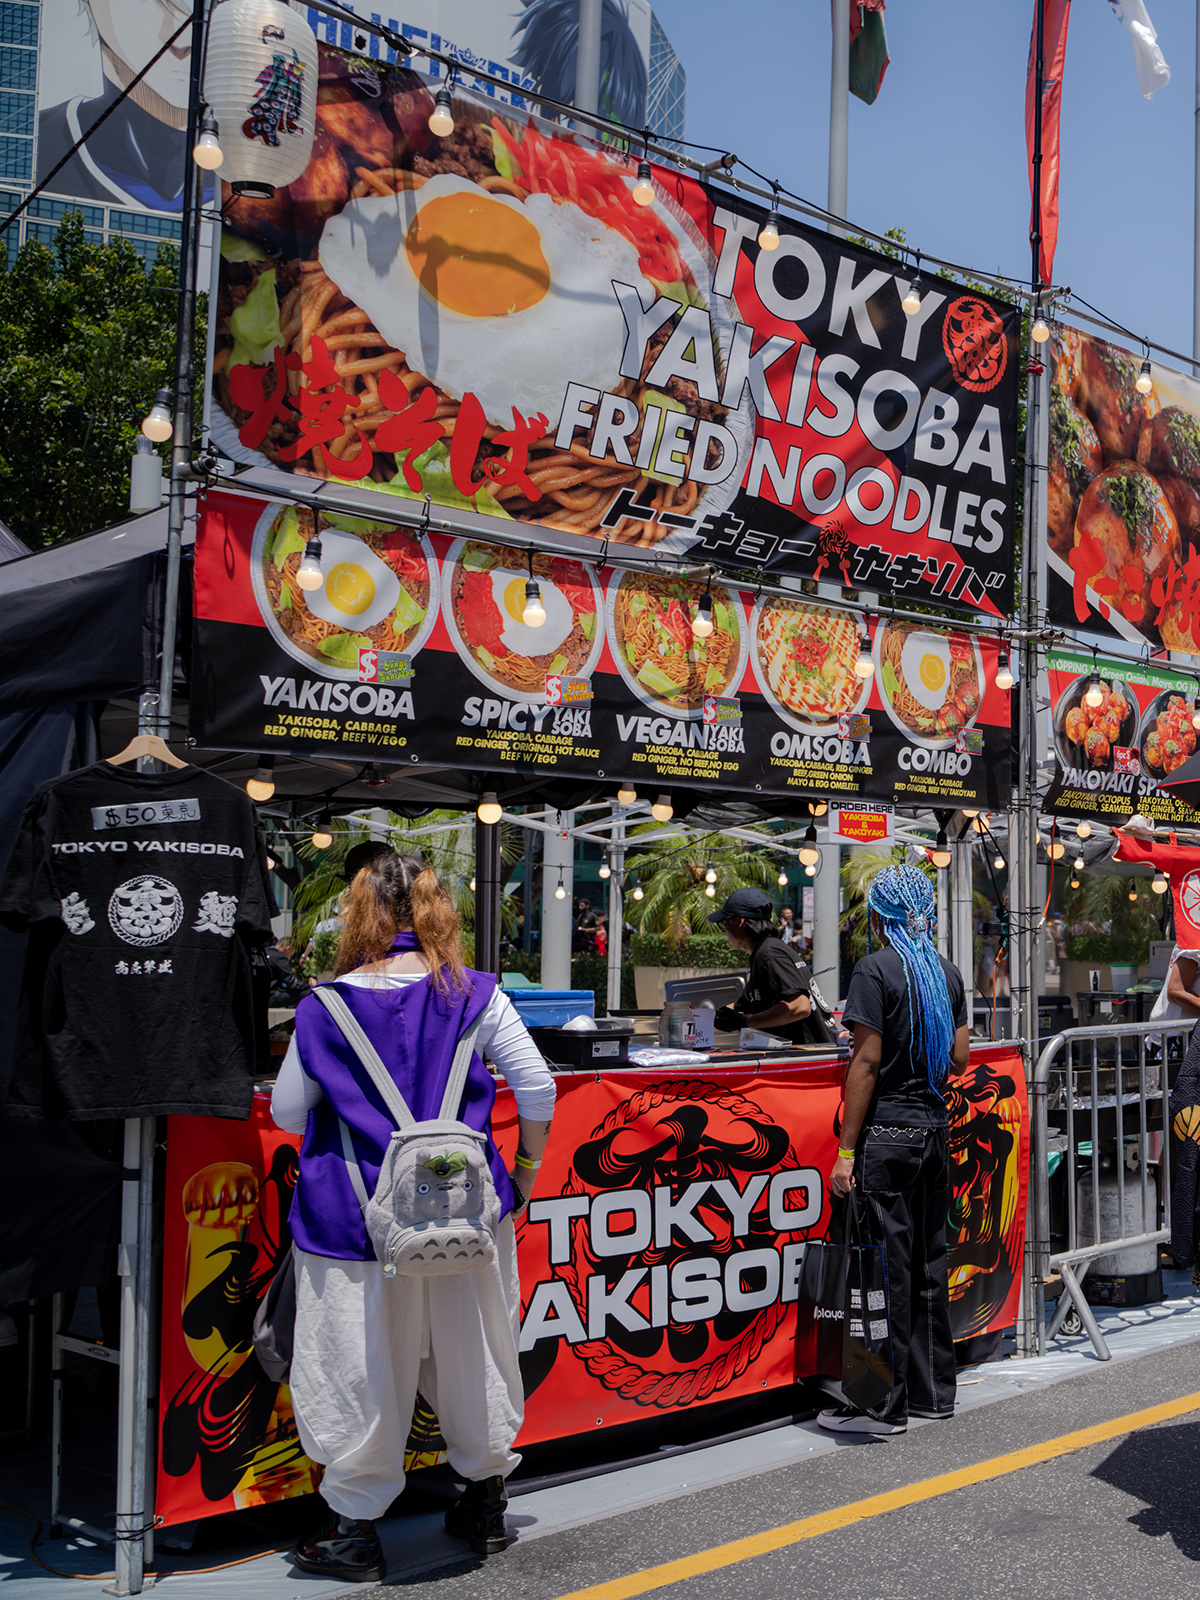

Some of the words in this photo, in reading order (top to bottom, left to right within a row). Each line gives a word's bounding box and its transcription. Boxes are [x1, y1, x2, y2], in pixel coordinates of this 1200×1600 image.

[611, 279, 1007, 485] YAKISOBA
[554, 380, 738, 485] FRIED
[745, 436, 1007, 554] NOODLES
[600, 487, 816, 562] トーキョー
[853, 543, 1006, 604] ヤキソバ
[384, 659, 409, 671] Tokyo
[379, 669, 416, 683] Yakisoba
[1052, 659, 1088, 675] TOPPING
[1101, 668, 1125, 681] Green
[1126, 672, 1150, 686] Onion,
[1151, 676, 1173, 690] Mayo,
[1176, 681, 1188, 691] OG
[259, 675, 416, 720] YAKISOBA
[460, 696, 552, 733] SPICY
[552, 706, 592, 724] YAKI
[264, 724, 287, 736] RED
[290, 727, 339, 741] GINGER,
[277, 714, 342, 731] YAKISOBA,
[345, 721, 397, 734] CABBAGE
[550, 721, 593, 738] SOBA
[616, 714, 709, 749] VEGAN
[486, 729, 533, 743] YAKISOBA,
[535, 734, 573, 746] CABBAGE
[709, 725, 744, 742] YAKI
[455, 736, 474, 746] RED
[474, 738, 511, 751] GINGER,
[512, 741, 554, 754] ORIGINAL
[555, 746, 574, 756] HOT
[574, 747, 600, 758] SAUCE
[645, 744, 686, 757] YAKISOBA,
[686, 749, 719, 760] CABBAGE
[708, 737, 745, 754] SOBA
[770, 731, 872, 766] OMSOBA
[500, 751, 521, 761] BEEF
[632, 752, 647, 762] RED
[648, 754, 679, 766] GINGER,
[679, 757, 693, 767] NO
[723, 762, 739, 772] EGG
[897, 746, 972, 776] COMBO
[656, 765, 691, 777] W/GREEN
[693, 767, 719, 779] ONION
[829, 771, 853, 782] ONION
[835, 763, 848, 772] RED
[848, 764, 873, 775] GINGER
[787, 777, 808, 787] MAYO
[815, 780, 830, 789] EGG
[830, 781, 859, 791] OMELETTE
[894, 782, 906, 791] RED
[906, 784, 928, 794] GINGER,
[928, 786, 940, 794] BEEF
[939, 778, 963, 788] CABBAGE
[1060, 767, 1135, 793] TAKOYAKI
[1061, 789, 1097, 803] TAKOYAKI,
[1098, 795, 1131, 805] OCTOPUS
[1139, 796, 1174, 807] TAKOYAKI,
[831, 801, 867, 812] ORDER
[868, 804, 893, 814] HERE
[1054, 797, 1069, 807] RED
[1069, 799, 1100, 812] GINGER,
[1100, 803, 1134, 815] SEAWEED
[1136, 803, 1150, 811] RED
[1150, 805, 1176, 815] GINGER,
[105, 807, 156, 827] $50
[842, 813, 884, 823] YAKISOBA
[1170, 814, 1184, 822] HOT
[842, 828, 885, 837] TAKOYAKI
[52, 841, 128, 855] TOKYO
[133, 841, 245, 859] YAKISOBA
[529, 1168, 822, 1265] TOKYO
